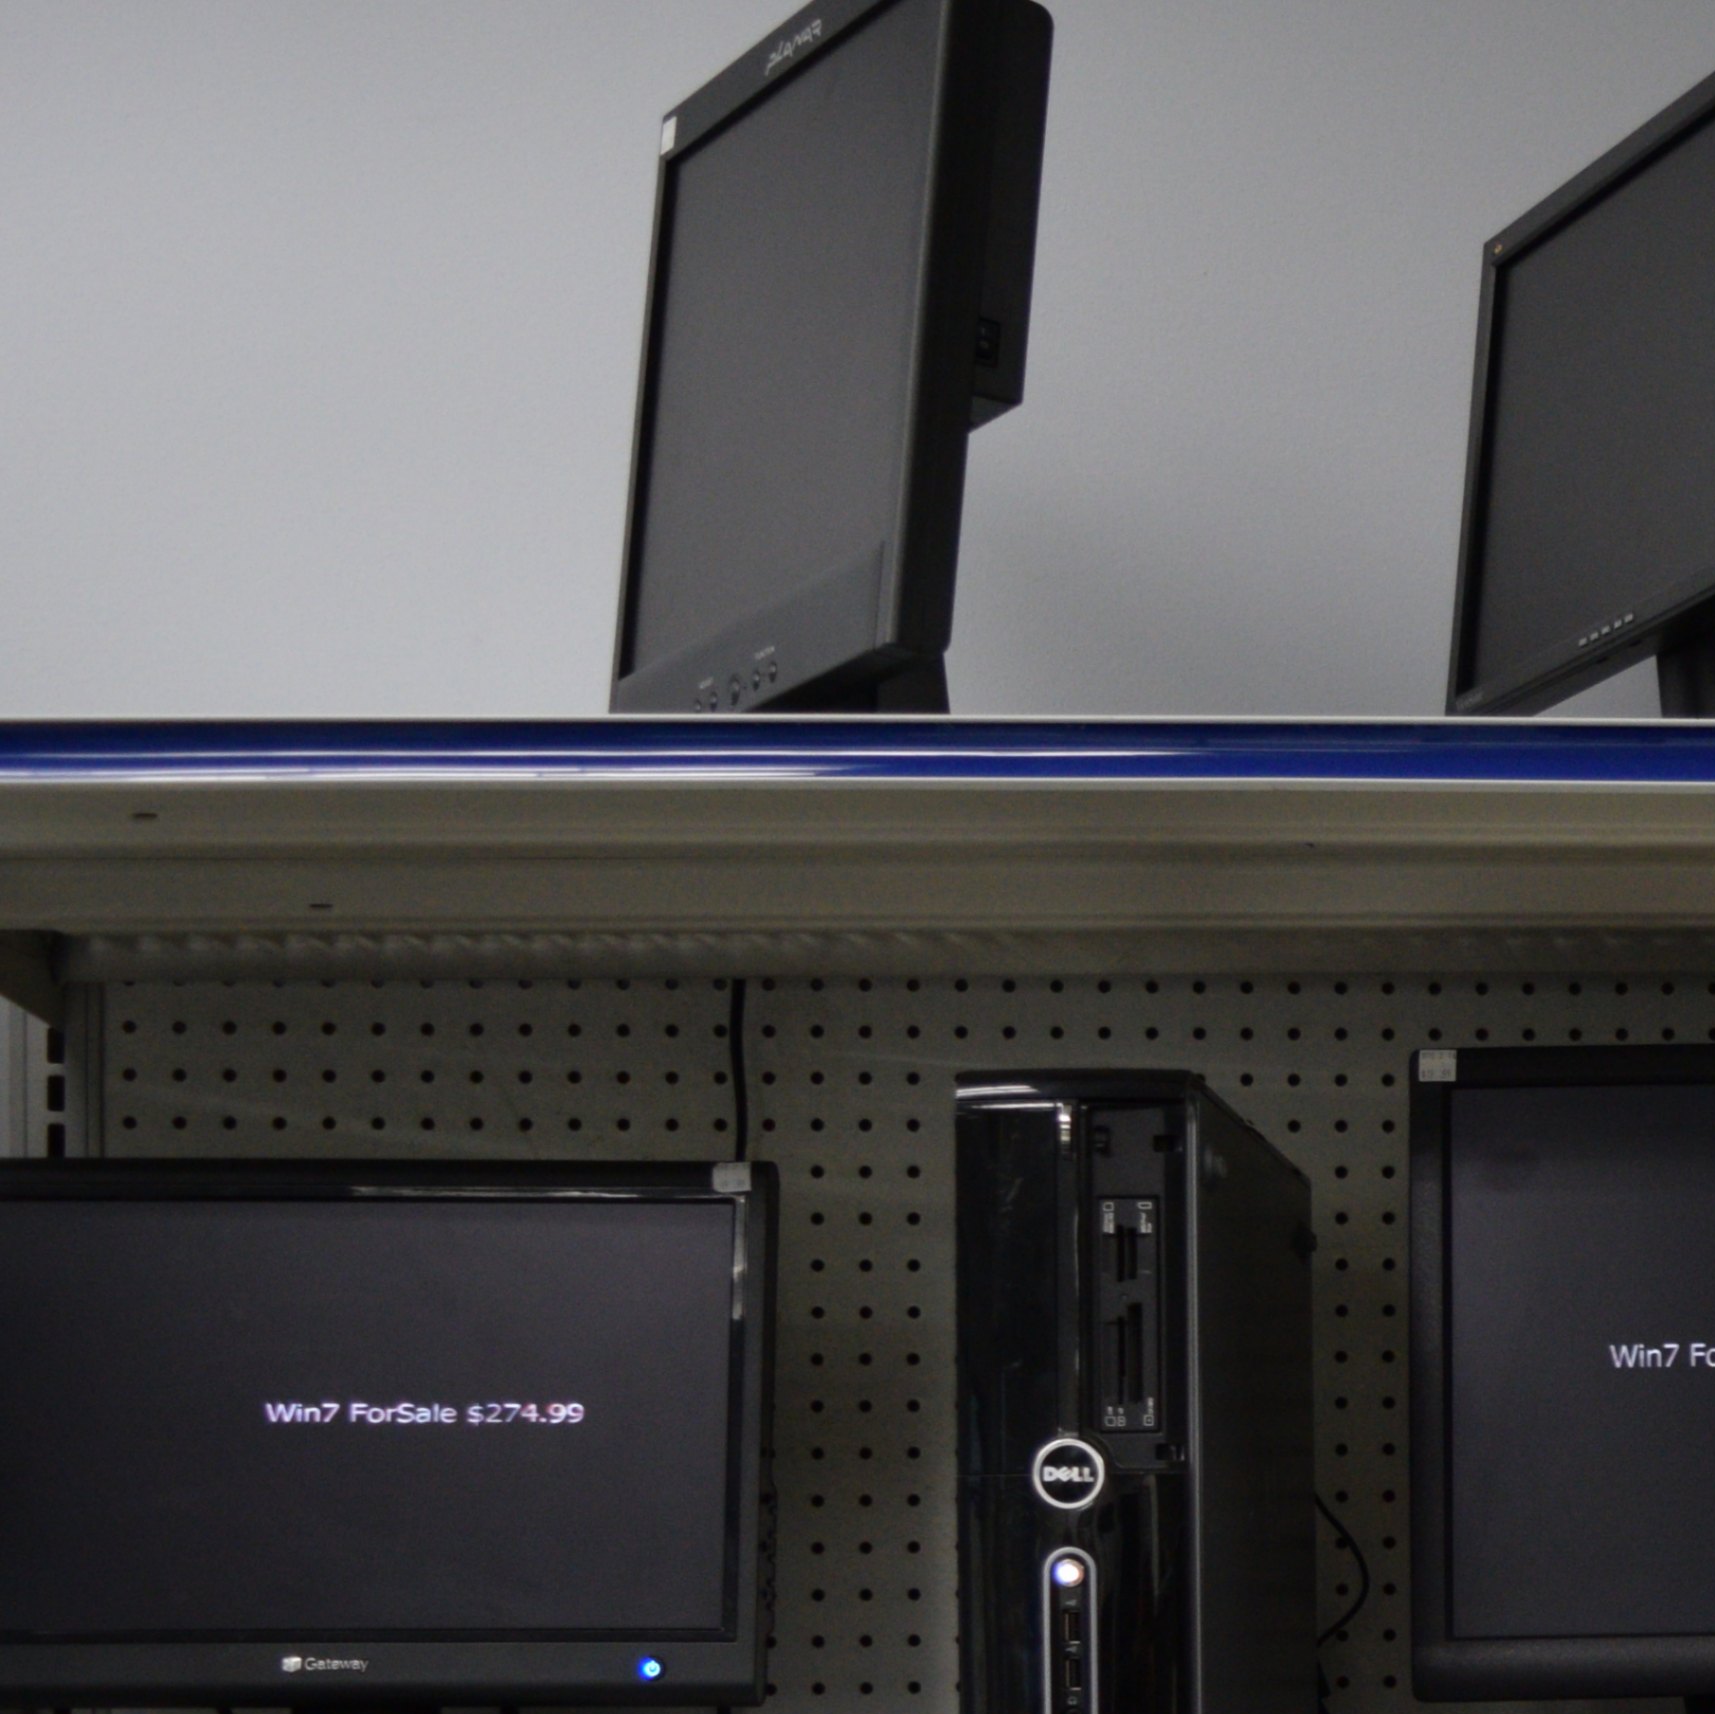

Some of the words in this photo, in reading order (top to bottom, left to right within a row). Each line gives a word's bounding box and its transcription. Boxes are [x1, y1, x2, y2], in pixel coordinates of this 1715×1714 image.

[1608, 1342, 1681, 1369] Win7
[264, 1401, 341, 1424] Win7
[348, 1401, 458, 1425] ForSale
[466, 1400, 586, 1427] $274.99
[1042, 1465, 1095, 1483] DELL
[304, 1656, 370, 1673] Gateway
